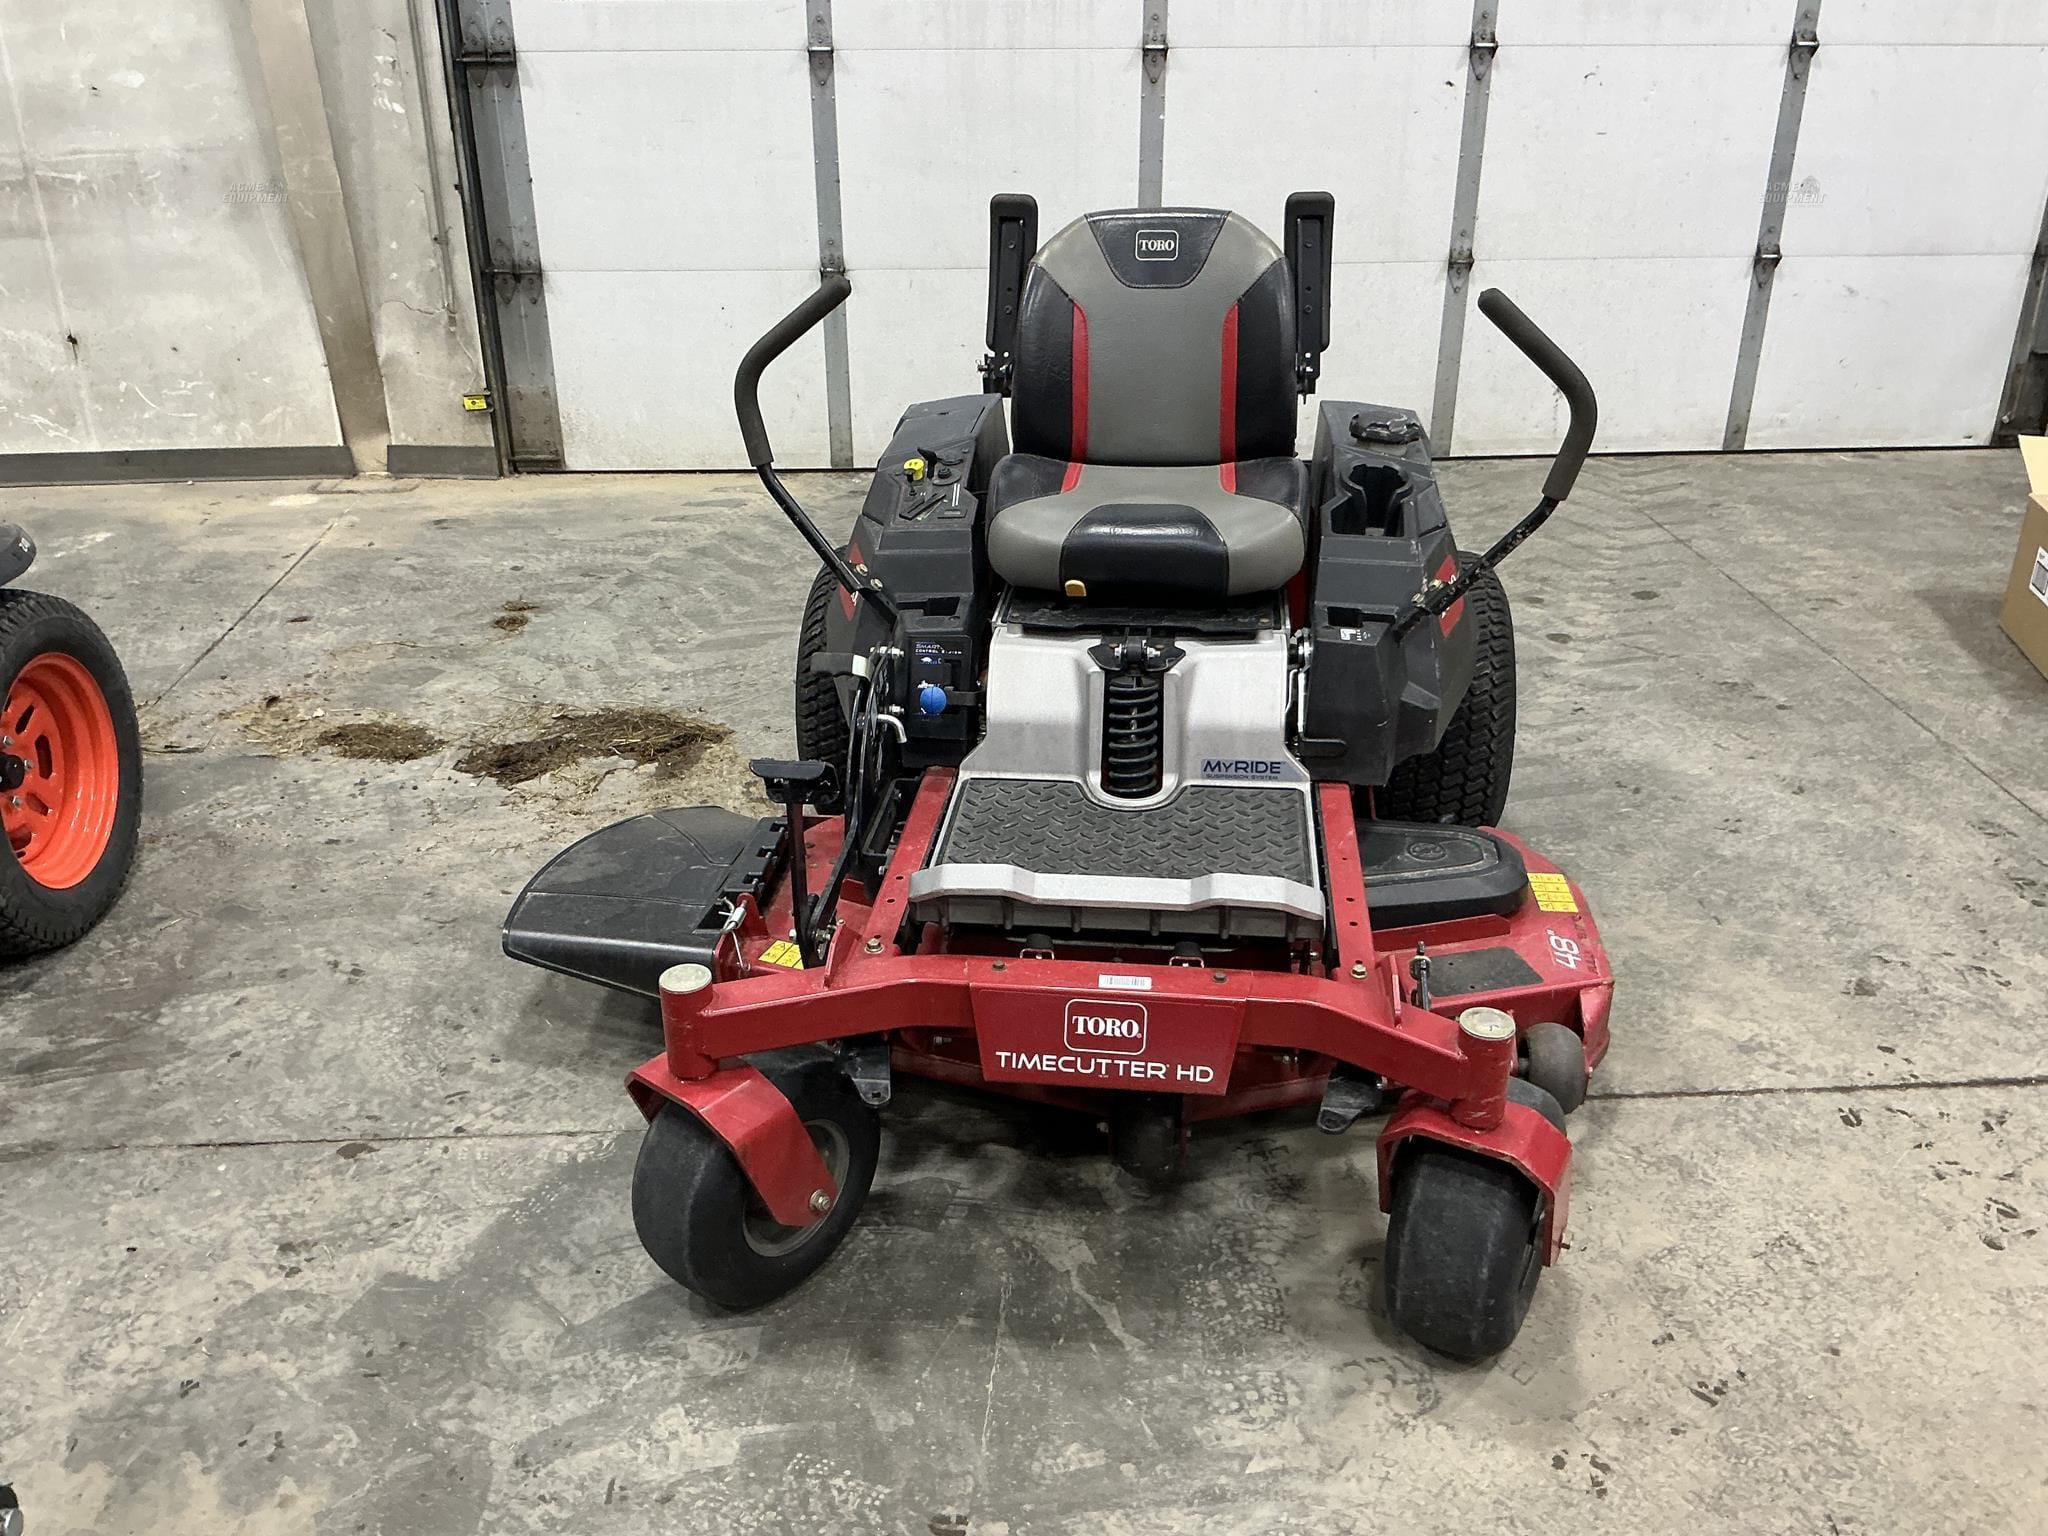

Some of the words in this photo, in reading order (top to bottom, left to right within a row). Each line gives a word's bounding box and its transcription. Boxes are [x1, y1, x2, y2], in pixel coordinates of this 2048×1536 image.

[1139, 239, 1175, 252] TORO
[1072, 1015, 1143, 1039] TORO
[995, 1050, 1170, 1080] TIMECUTTER
[1175, 1063, 1214, 1083] HD
